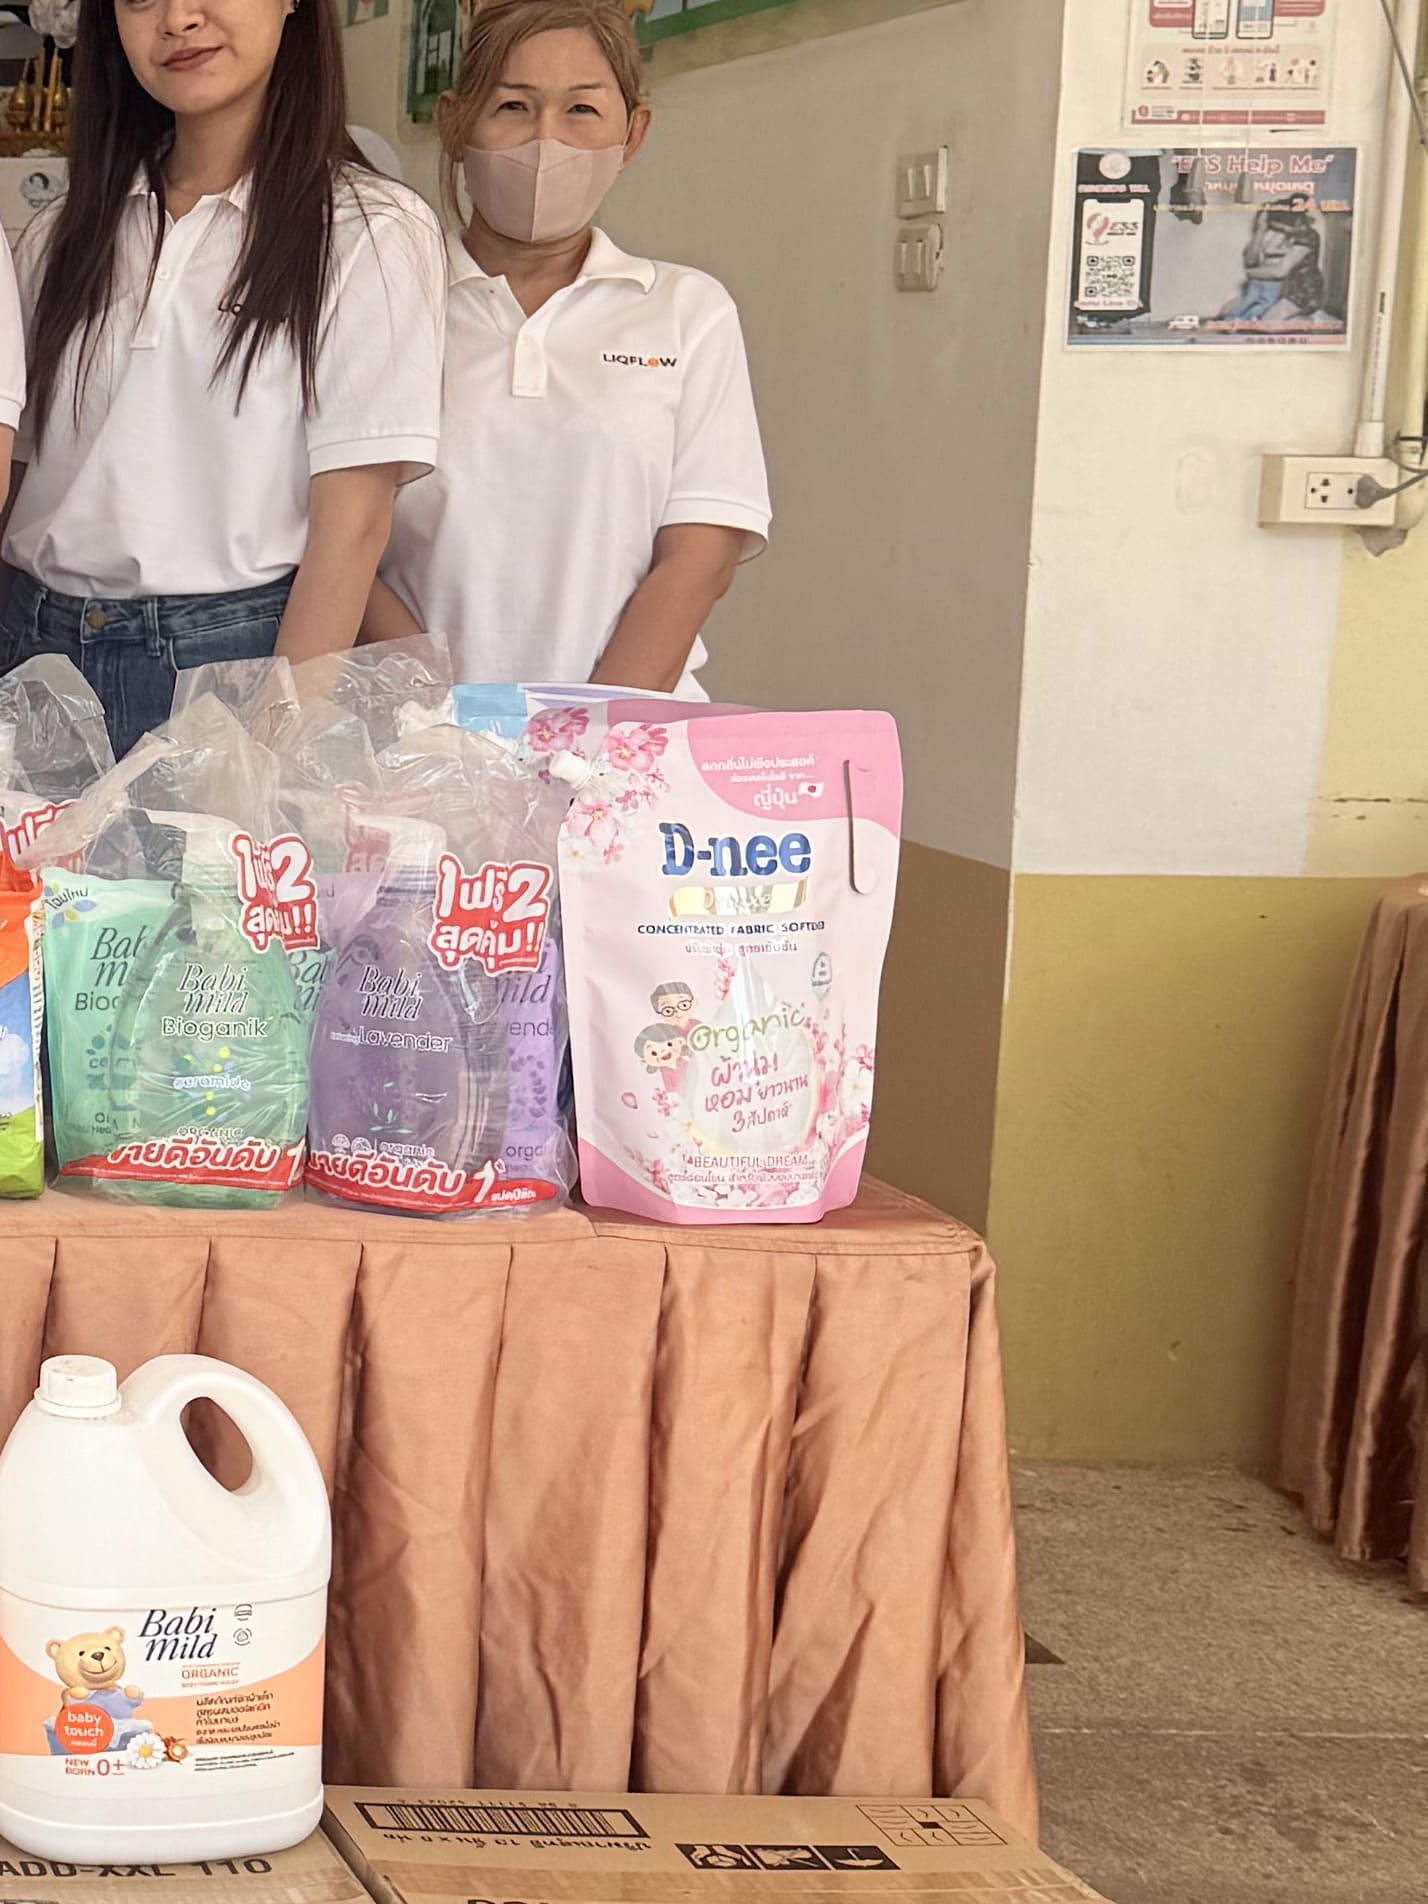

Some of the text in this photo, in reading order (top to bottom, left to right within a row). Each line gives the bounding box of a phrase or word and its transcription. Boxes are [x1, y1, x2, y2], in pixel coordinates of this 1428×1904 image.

[1228, 155, 1283, 175] Help
[602, 351, 678, 370] LIQFLOW
[753, 784, 798, 810] ญี่ปุ่น
[659, 822, 811, 876] D-nee
[637, 924, 774, 935] CONCENTRATED FABRIC
[182, 963, 248, 992] Babi
[359, 966, 421, 998] Babi
[161, 1017, 269, 1037] Bioganik
[689, 1006, 806, 1052] Organic
[359, 1028, 452, 1053] Lavender
[138, 1607, 217, 1639] Babi
